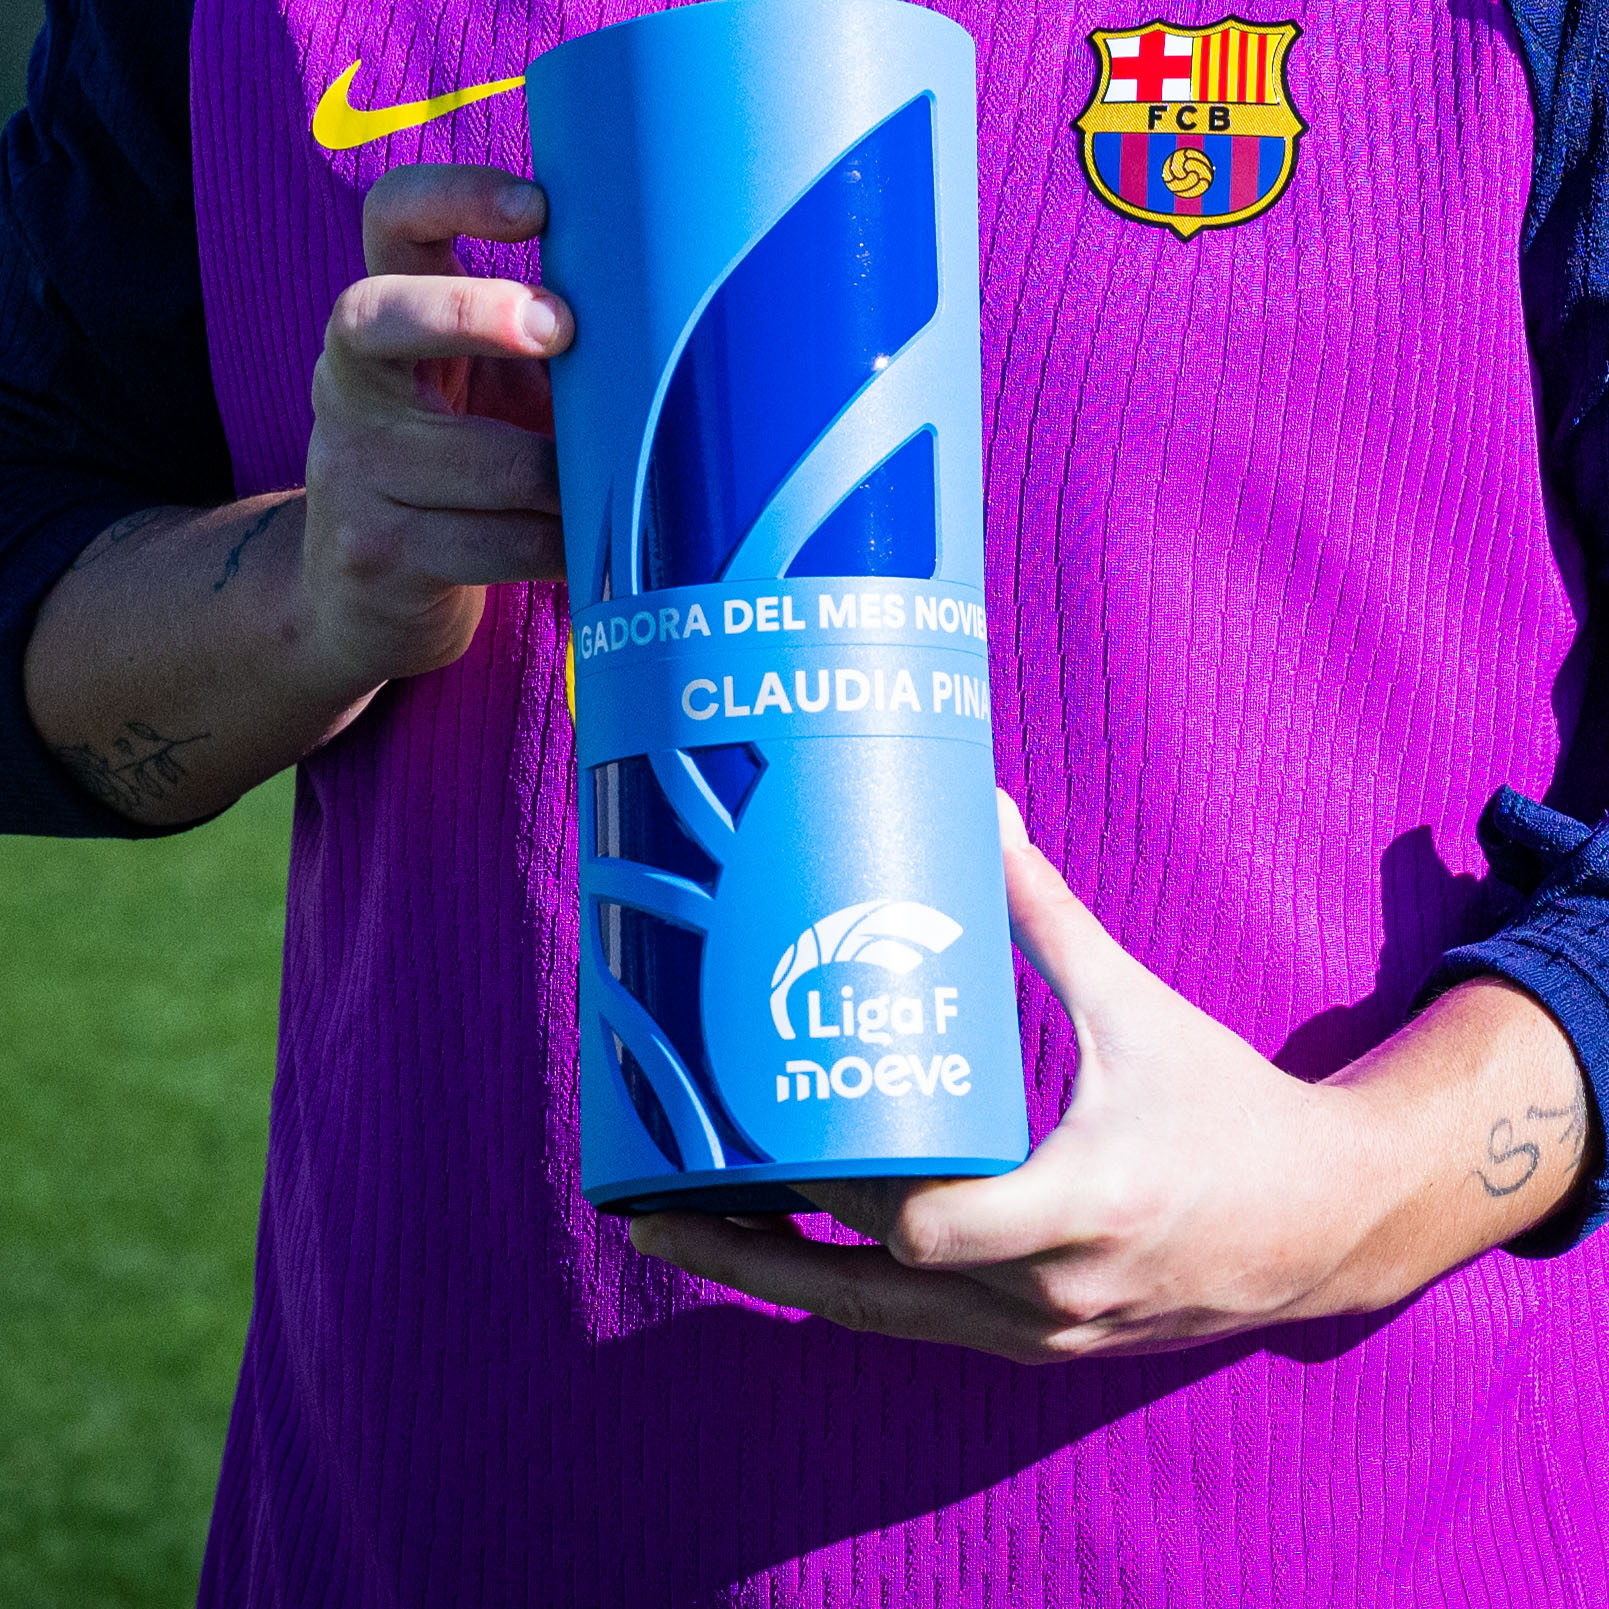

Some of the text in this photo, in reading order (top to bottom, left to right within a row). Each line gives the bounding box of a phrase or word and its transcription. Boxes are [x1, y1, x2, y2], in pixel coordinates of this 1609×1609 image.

[1148, 105, 1231, 131] FCB
[723, 595, 806, 635] DEL
[819, 593, 906, 631] MES
[915, 595, 988, 642] NOVIE
[681, 668, 991, 724] CLAUDIA PINA
[807, 985, 958, 1047] Liga F
[776, 1053, 972, 1103] moeve
